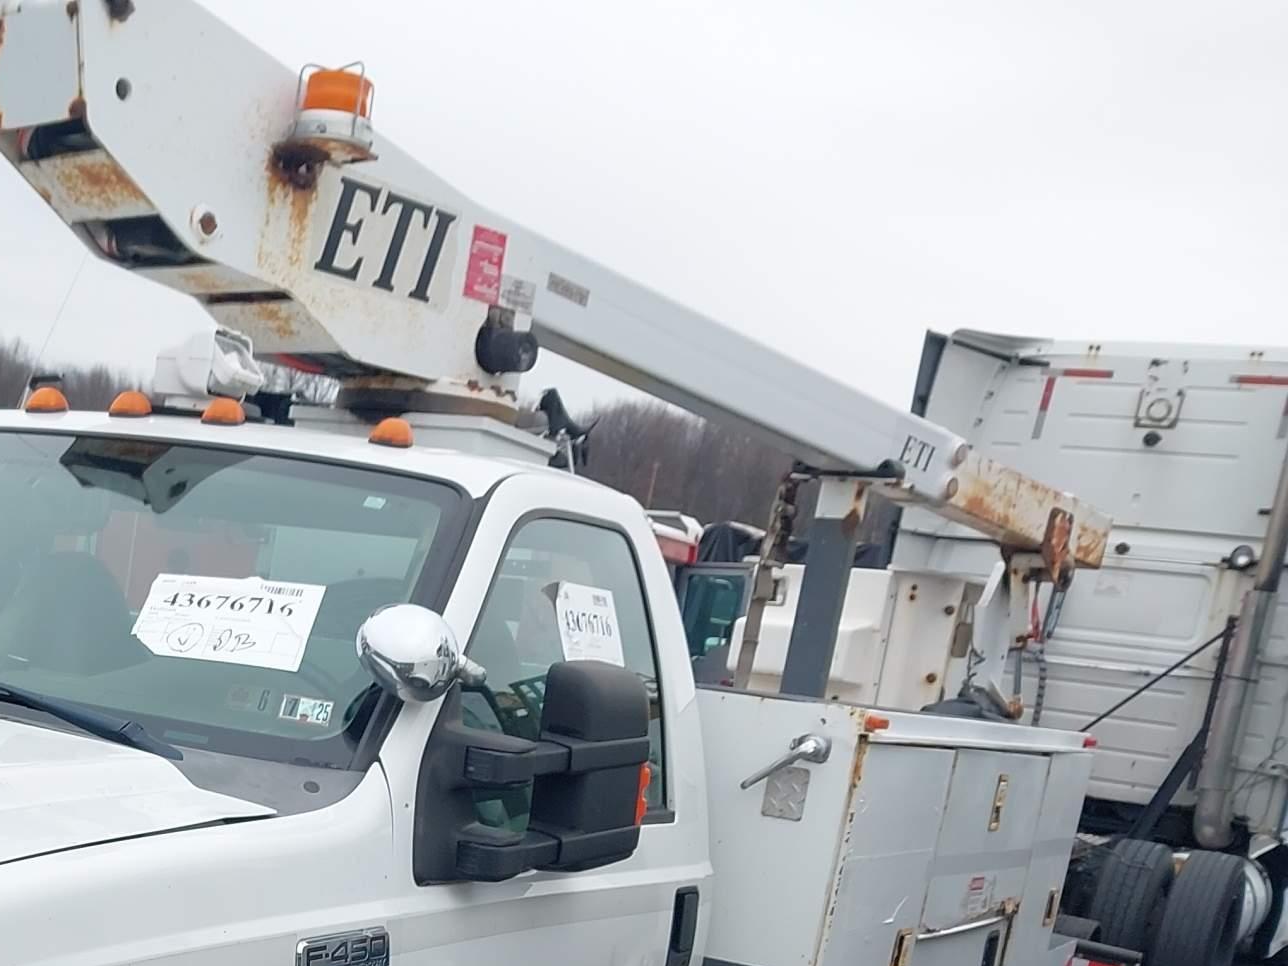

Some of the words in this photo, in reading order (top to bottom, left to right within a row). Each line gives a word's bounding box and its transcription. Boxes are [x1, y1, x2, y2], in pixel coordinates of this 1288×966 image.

[314, 176, 457, 303] ETI
[899, 434, 936, 472] ETI
[163, 592, 295, 617] 43676716
